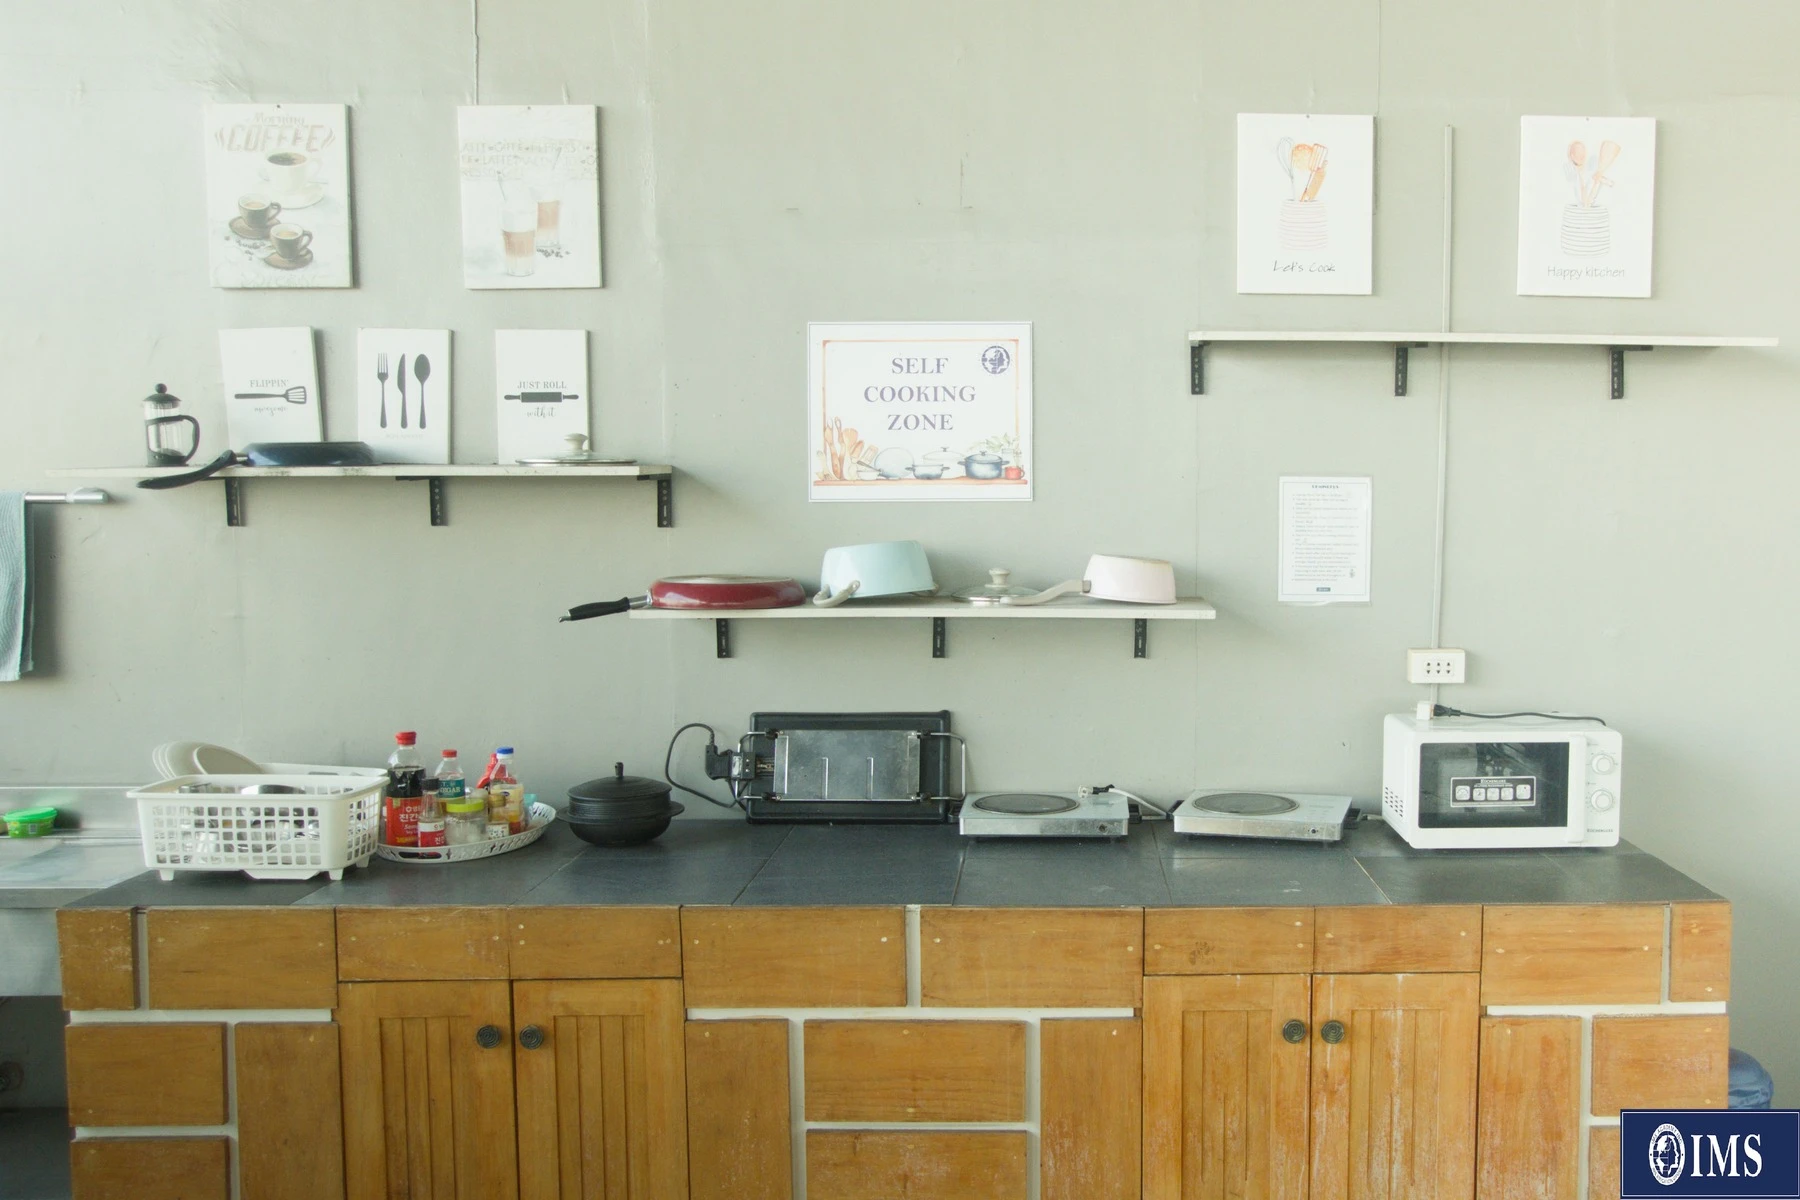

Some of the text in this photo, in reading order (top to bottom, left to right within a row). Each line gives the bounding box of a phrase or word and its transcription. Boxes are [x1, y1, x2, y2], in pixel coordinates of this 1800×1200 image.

[1273, 260, 1304, 273] Let's
[1547, 265, 1625, 280] Happy kitchen
[891, 357, 949, 375] SELF
[517, 381, 567, 389] JUST ROLL
[864, 385, 976, 403] COOKING
[887, 414, 954, 431] ZONE
